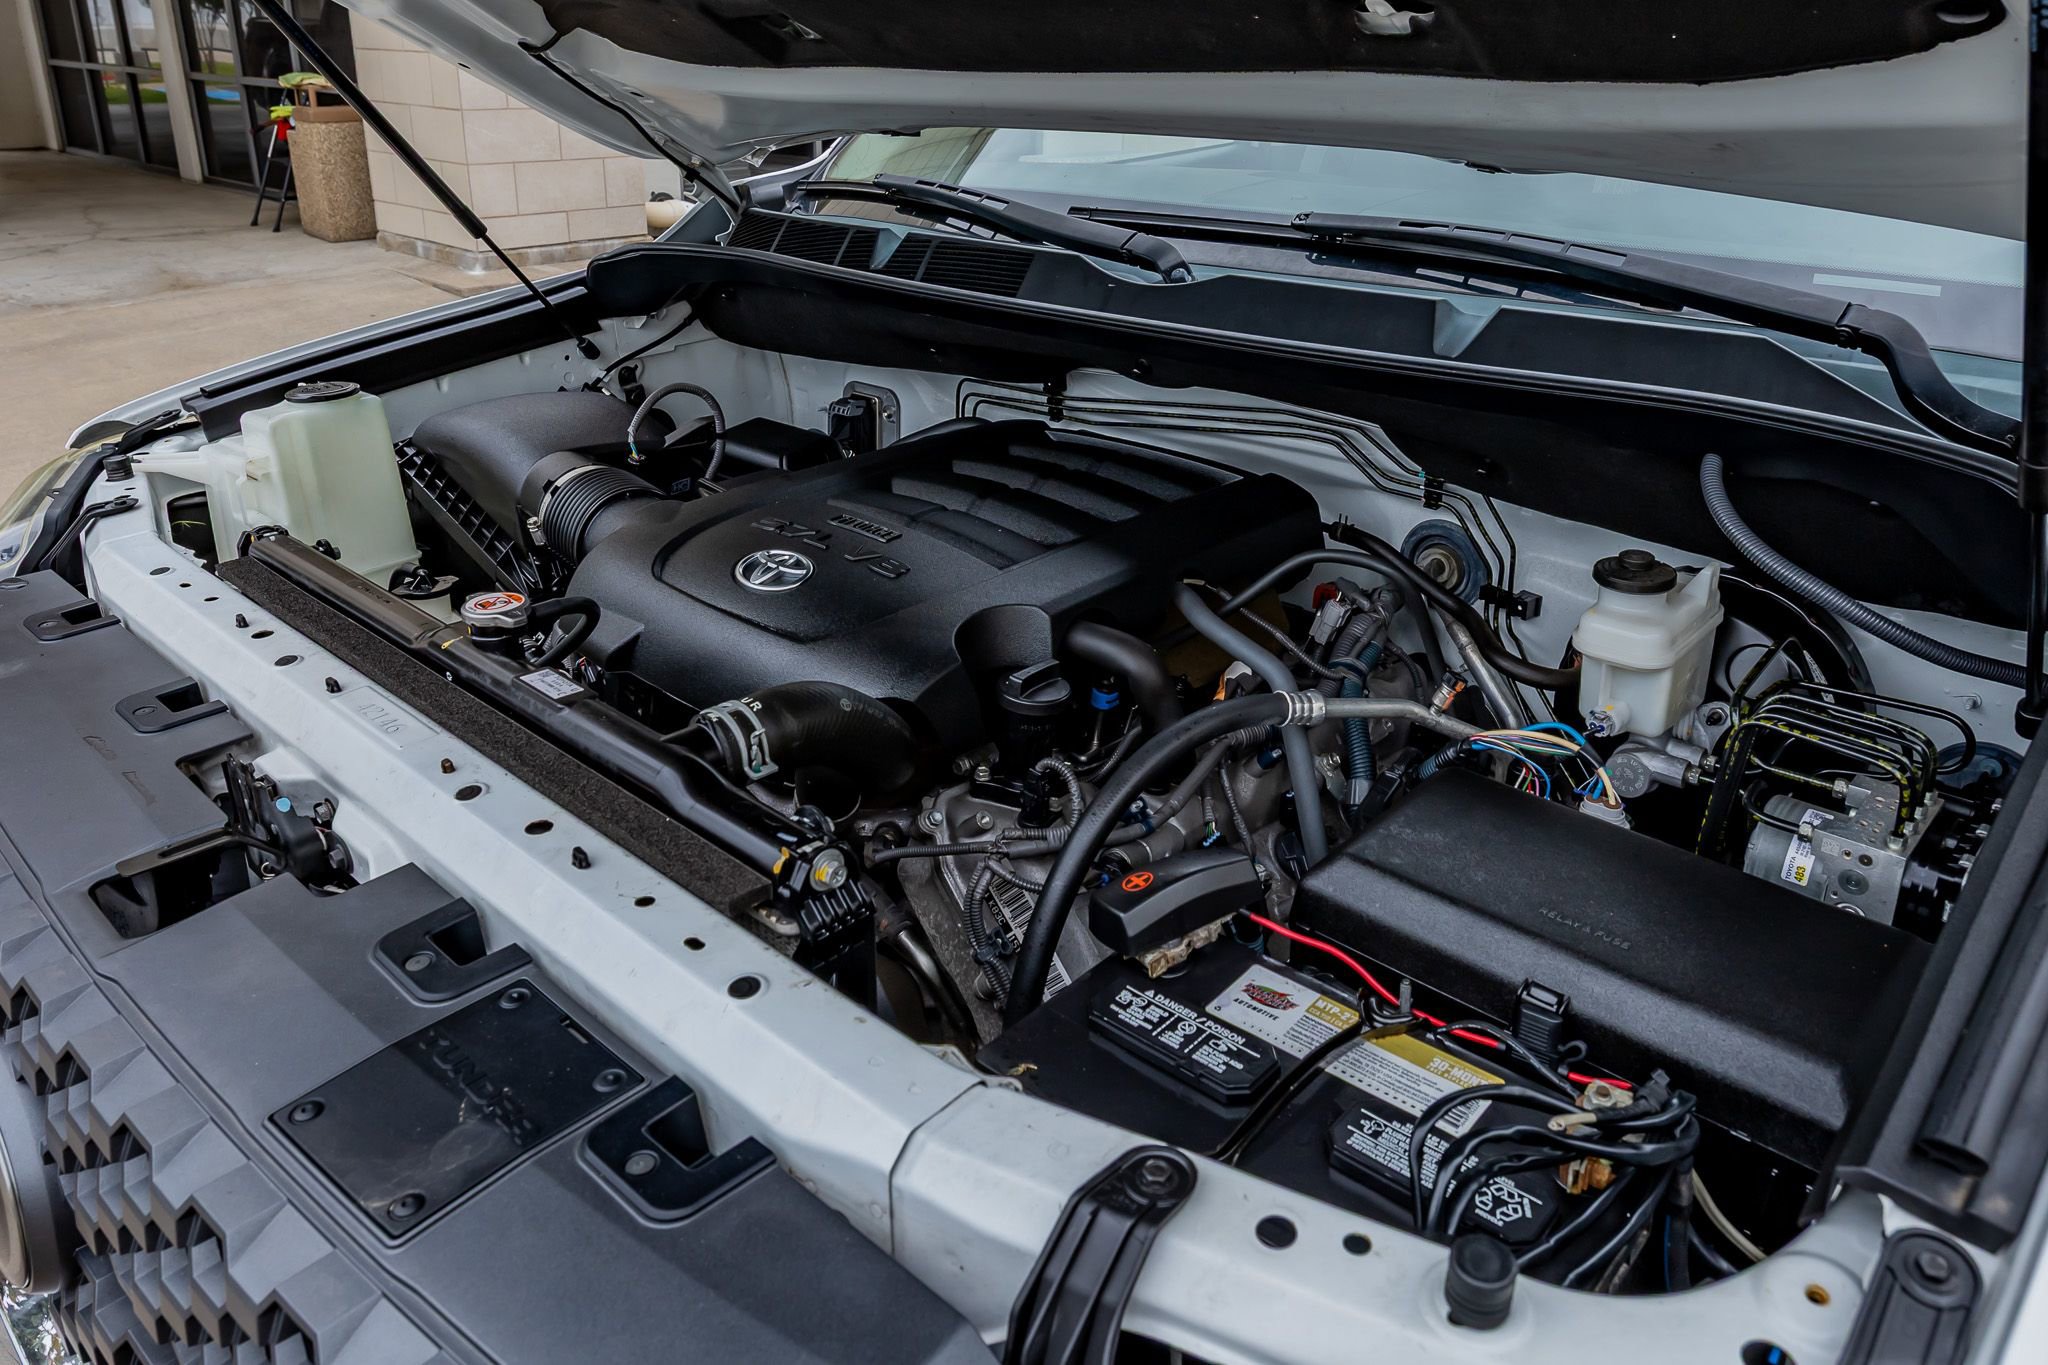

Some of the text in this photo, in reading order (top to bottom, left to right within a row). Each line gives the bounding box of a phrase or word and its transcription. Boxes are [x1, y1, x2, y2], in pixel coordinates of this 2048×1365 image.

[1784, 855, 1796, 879] TOYOTA
[1793, 864, 1806, 882] 483
[1537, 906, 1582, 927] RELAY
[1593, 929, 1632, 950] FUSE
[1153, 994, 1198, 1020] DANGER
[1203, 1019, 1246, 1045] POISON
[1233, 997, 1279, 1020] AUTOMOTIVE
